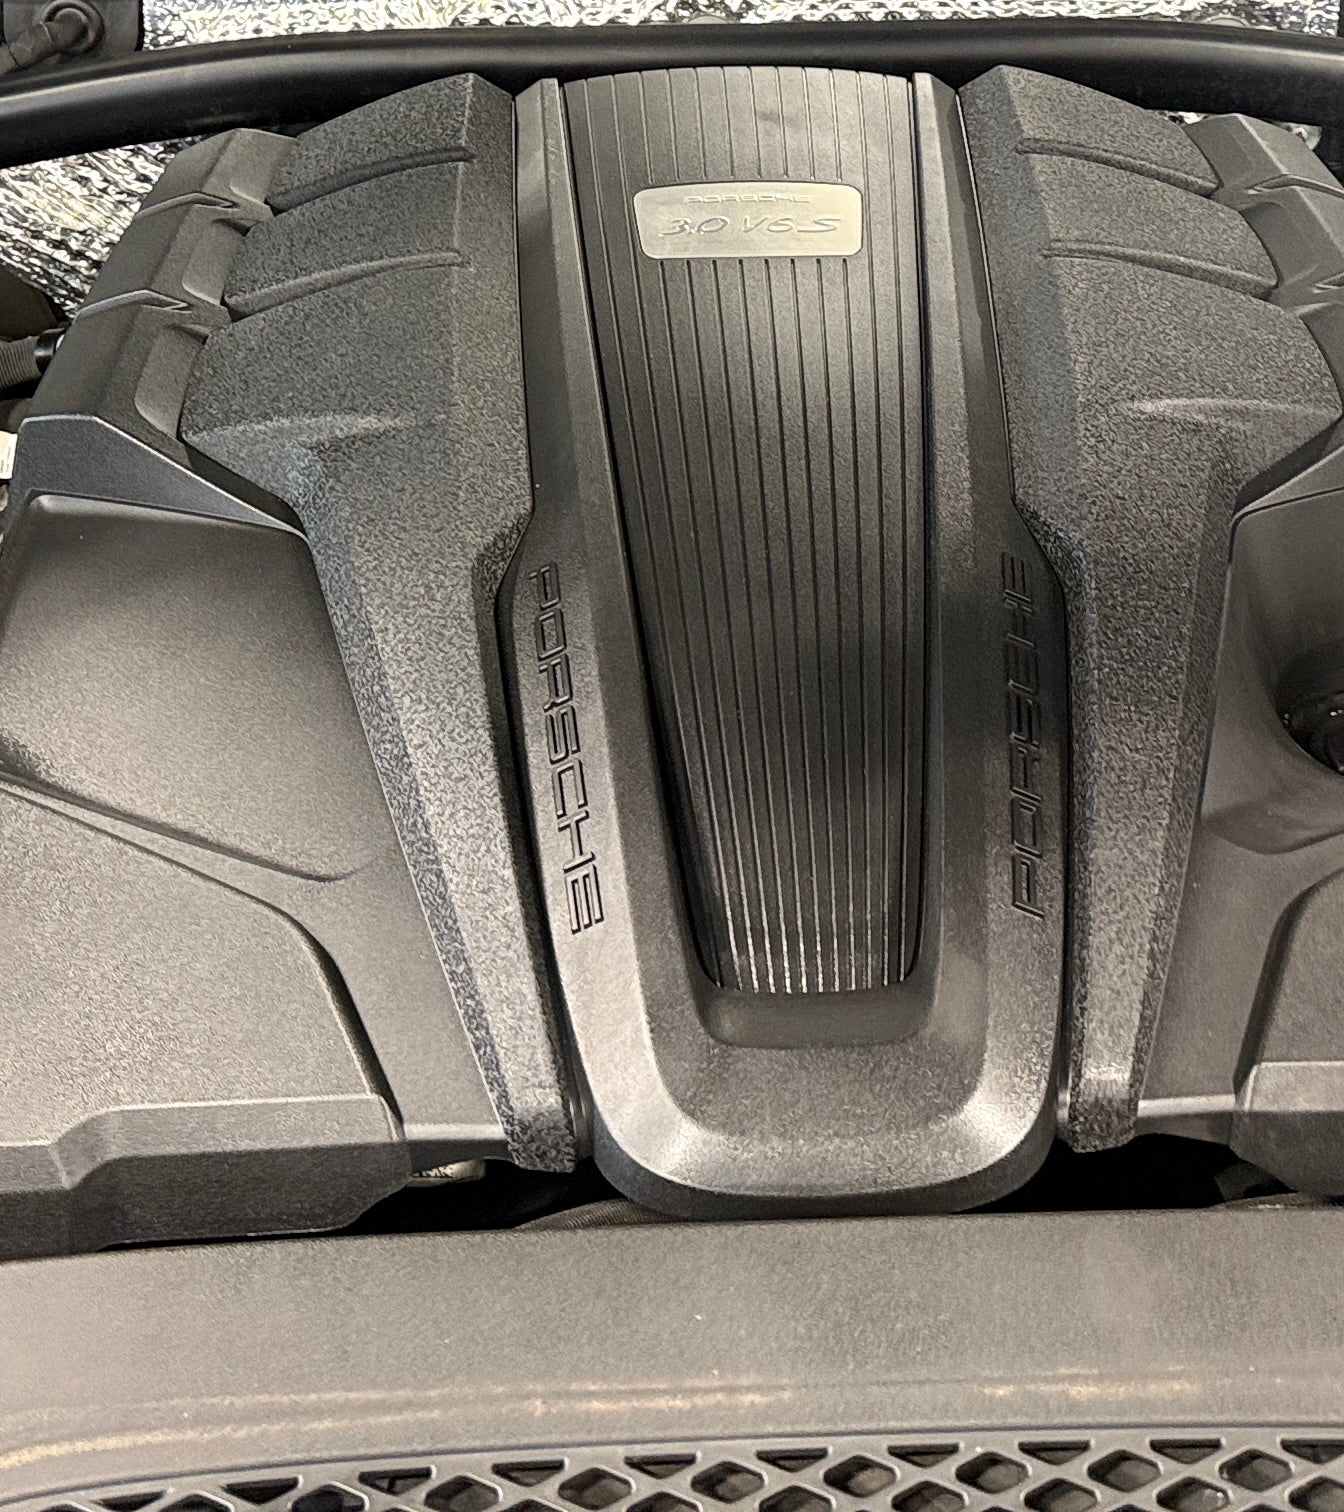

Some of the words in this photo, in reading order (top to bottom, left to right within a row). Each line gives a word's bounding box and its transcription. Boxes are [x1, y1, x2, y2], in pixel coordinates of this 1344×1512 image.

[658, 216, 731, 237] 3.0
[529, 562, 605, 935] PORSCHE
[1002, 552, 1045, 920] PORSCHE
